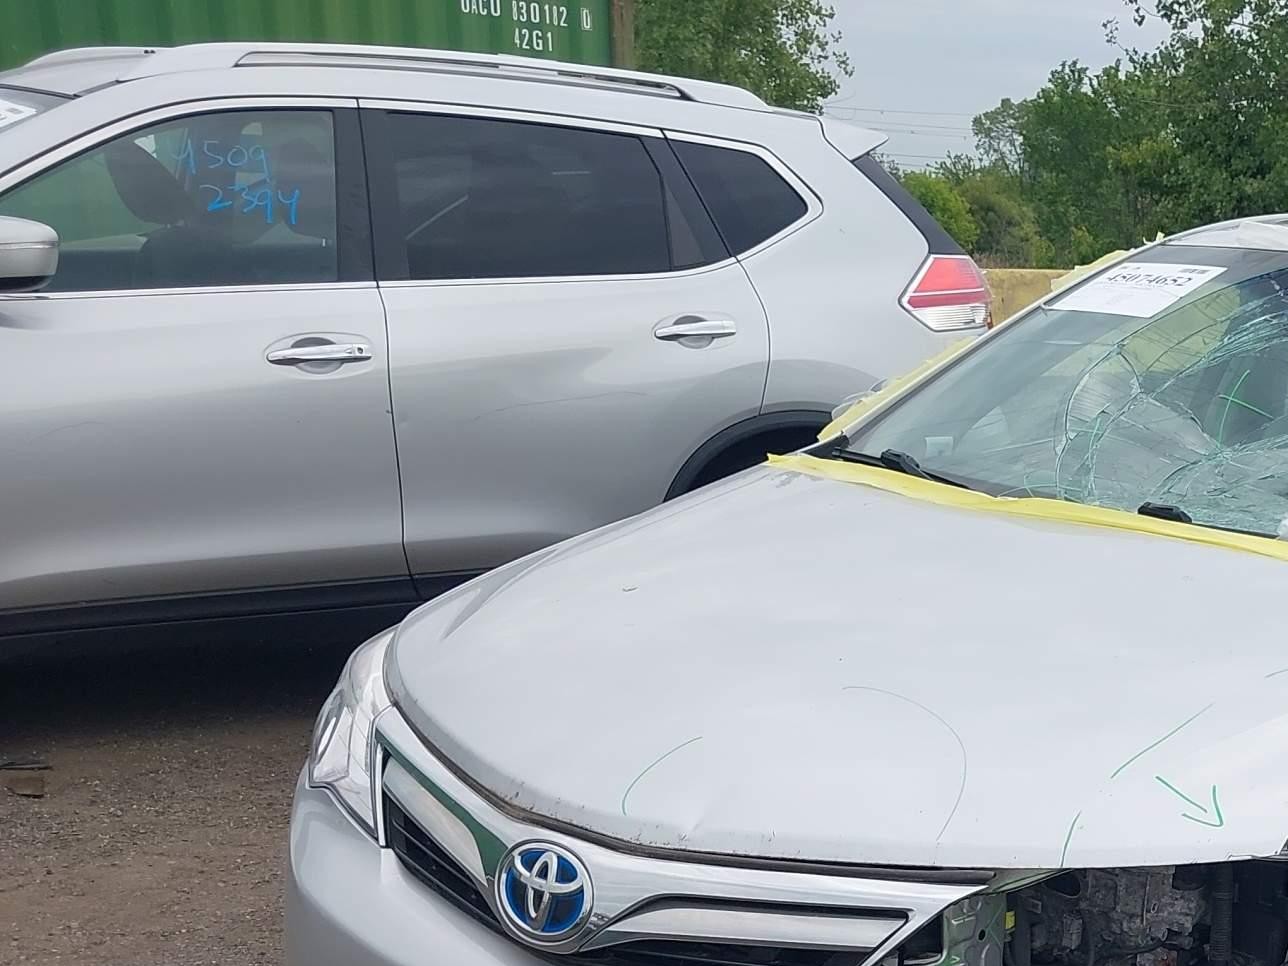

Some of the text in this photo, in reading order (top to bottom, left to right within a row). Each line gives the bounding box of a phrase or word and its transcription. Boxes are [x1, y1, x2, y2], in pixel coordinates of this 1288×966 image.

[512, 0, 569, 27] 830182
[514, 27, 553, 52] 42G1
[1106, 273, 1193, 287] 45074652
